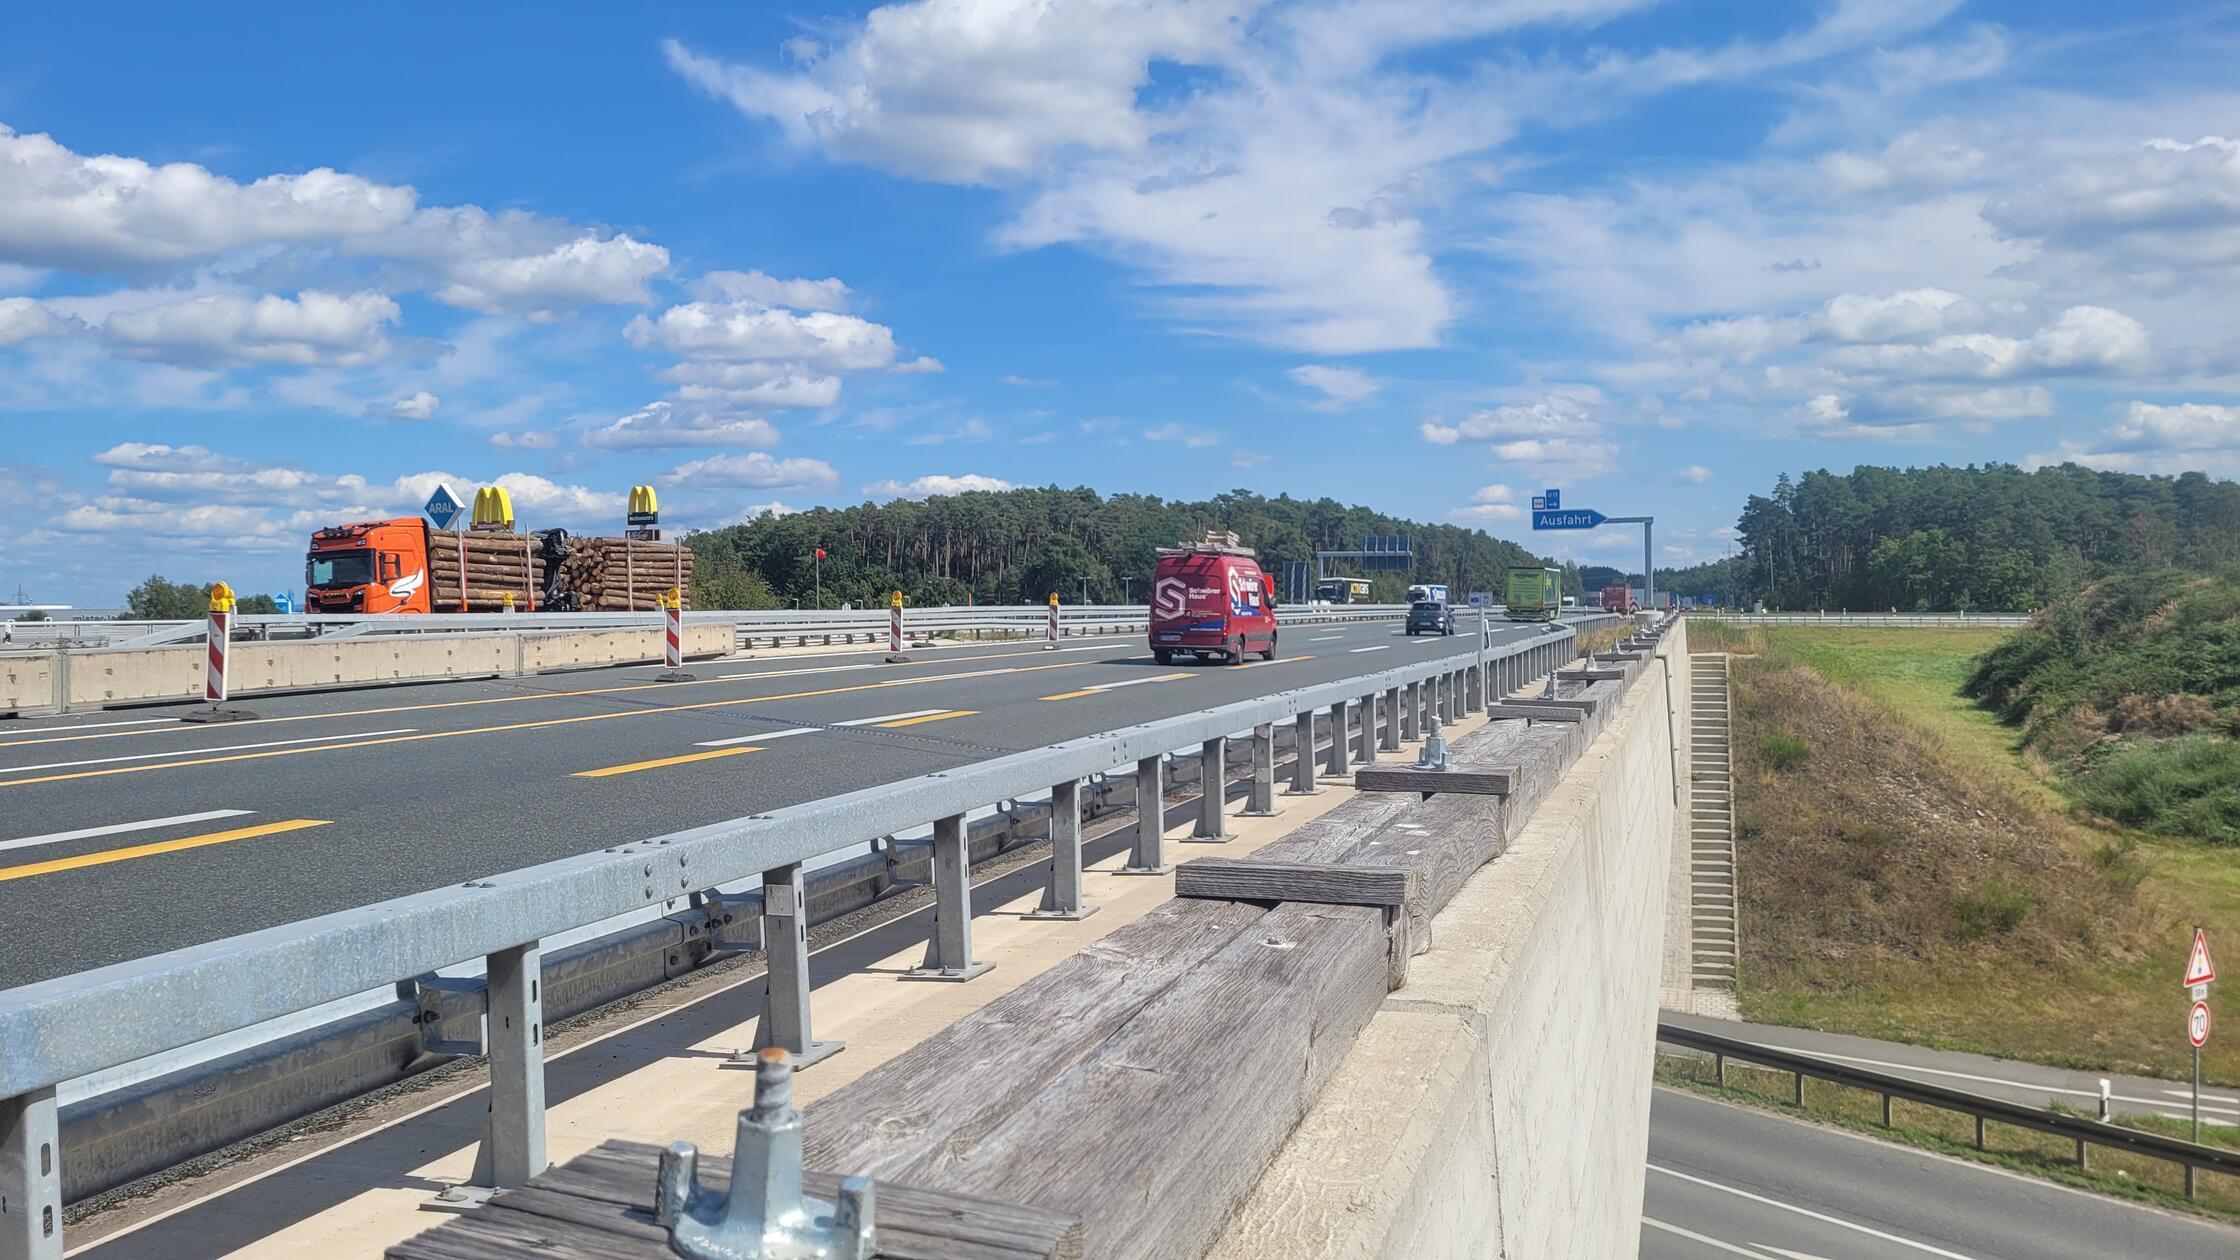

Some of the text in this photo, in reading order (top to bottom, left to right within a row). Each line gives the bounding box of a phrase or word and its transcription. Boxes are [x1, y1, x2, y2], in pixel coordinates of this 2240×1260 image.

[428, 502, 454, 515] ARAL
[1540, 514, 1592, 526] Ausfahrt
[2194, 1014, 2205, 1035] 70
